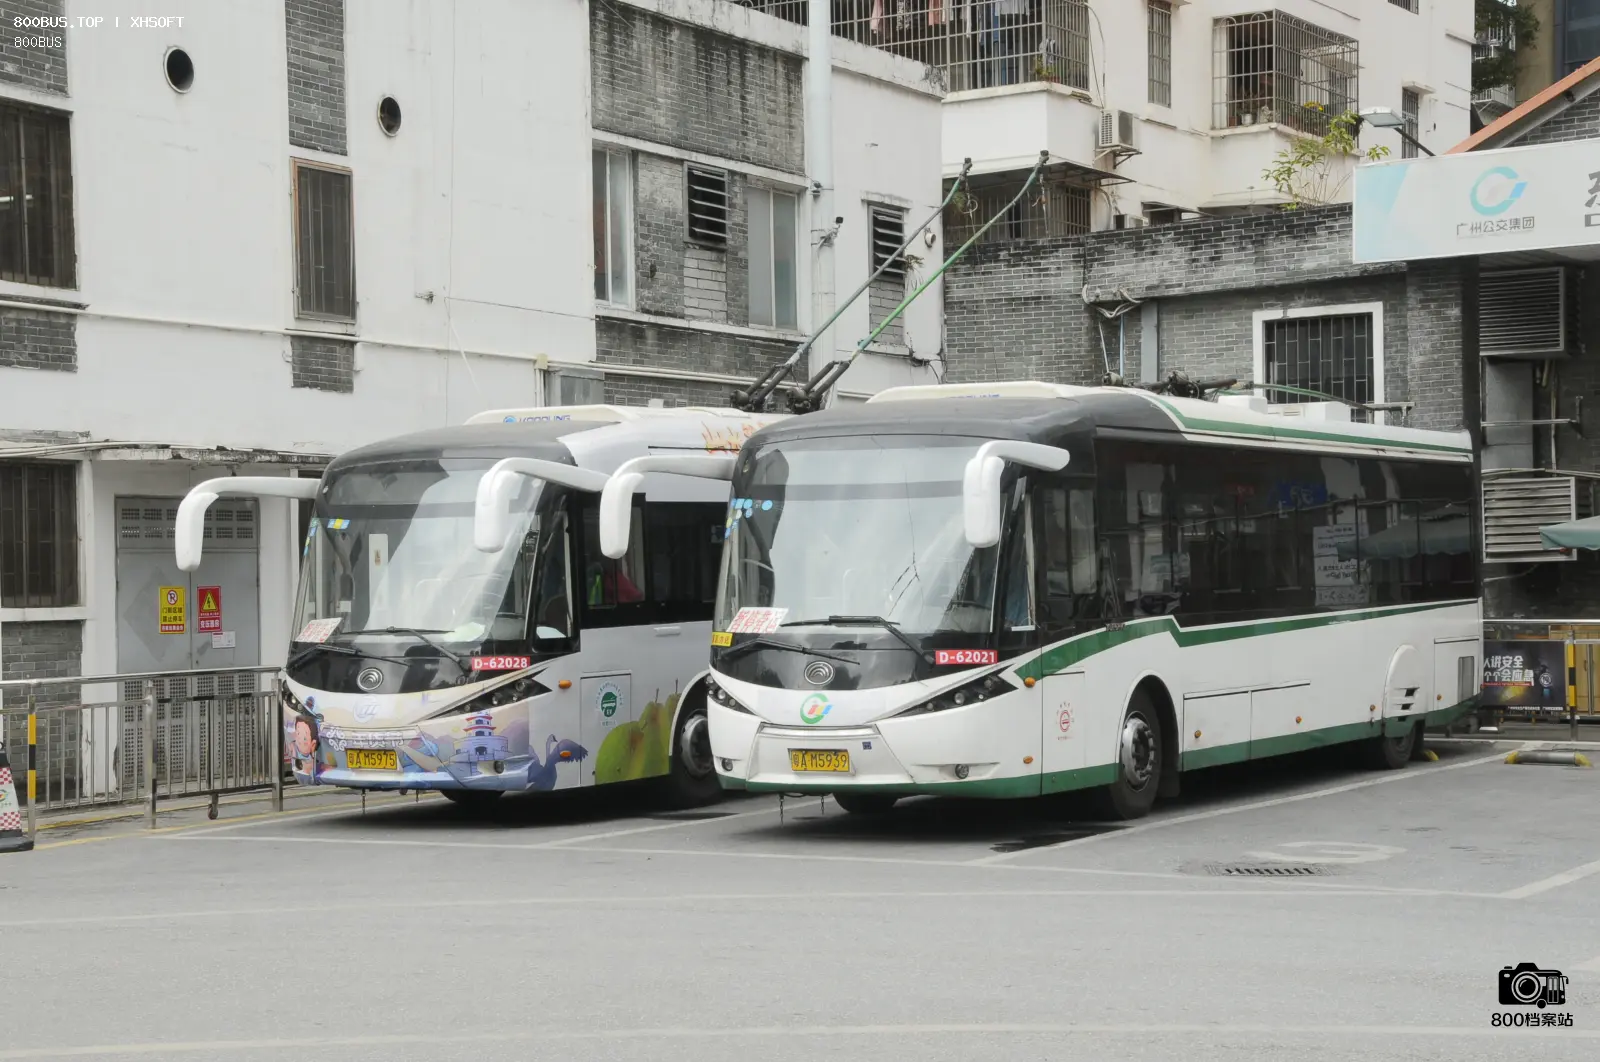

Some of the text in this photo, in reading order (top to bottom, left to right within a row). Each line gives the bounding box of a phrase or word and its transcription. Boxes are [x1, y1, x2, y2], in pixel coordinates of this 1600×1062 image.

[1456, 216, 1535, 236] 广州公交集团
[474, 657, 528, 669] D-62028
[939, 651, 995, 663] D-62021
